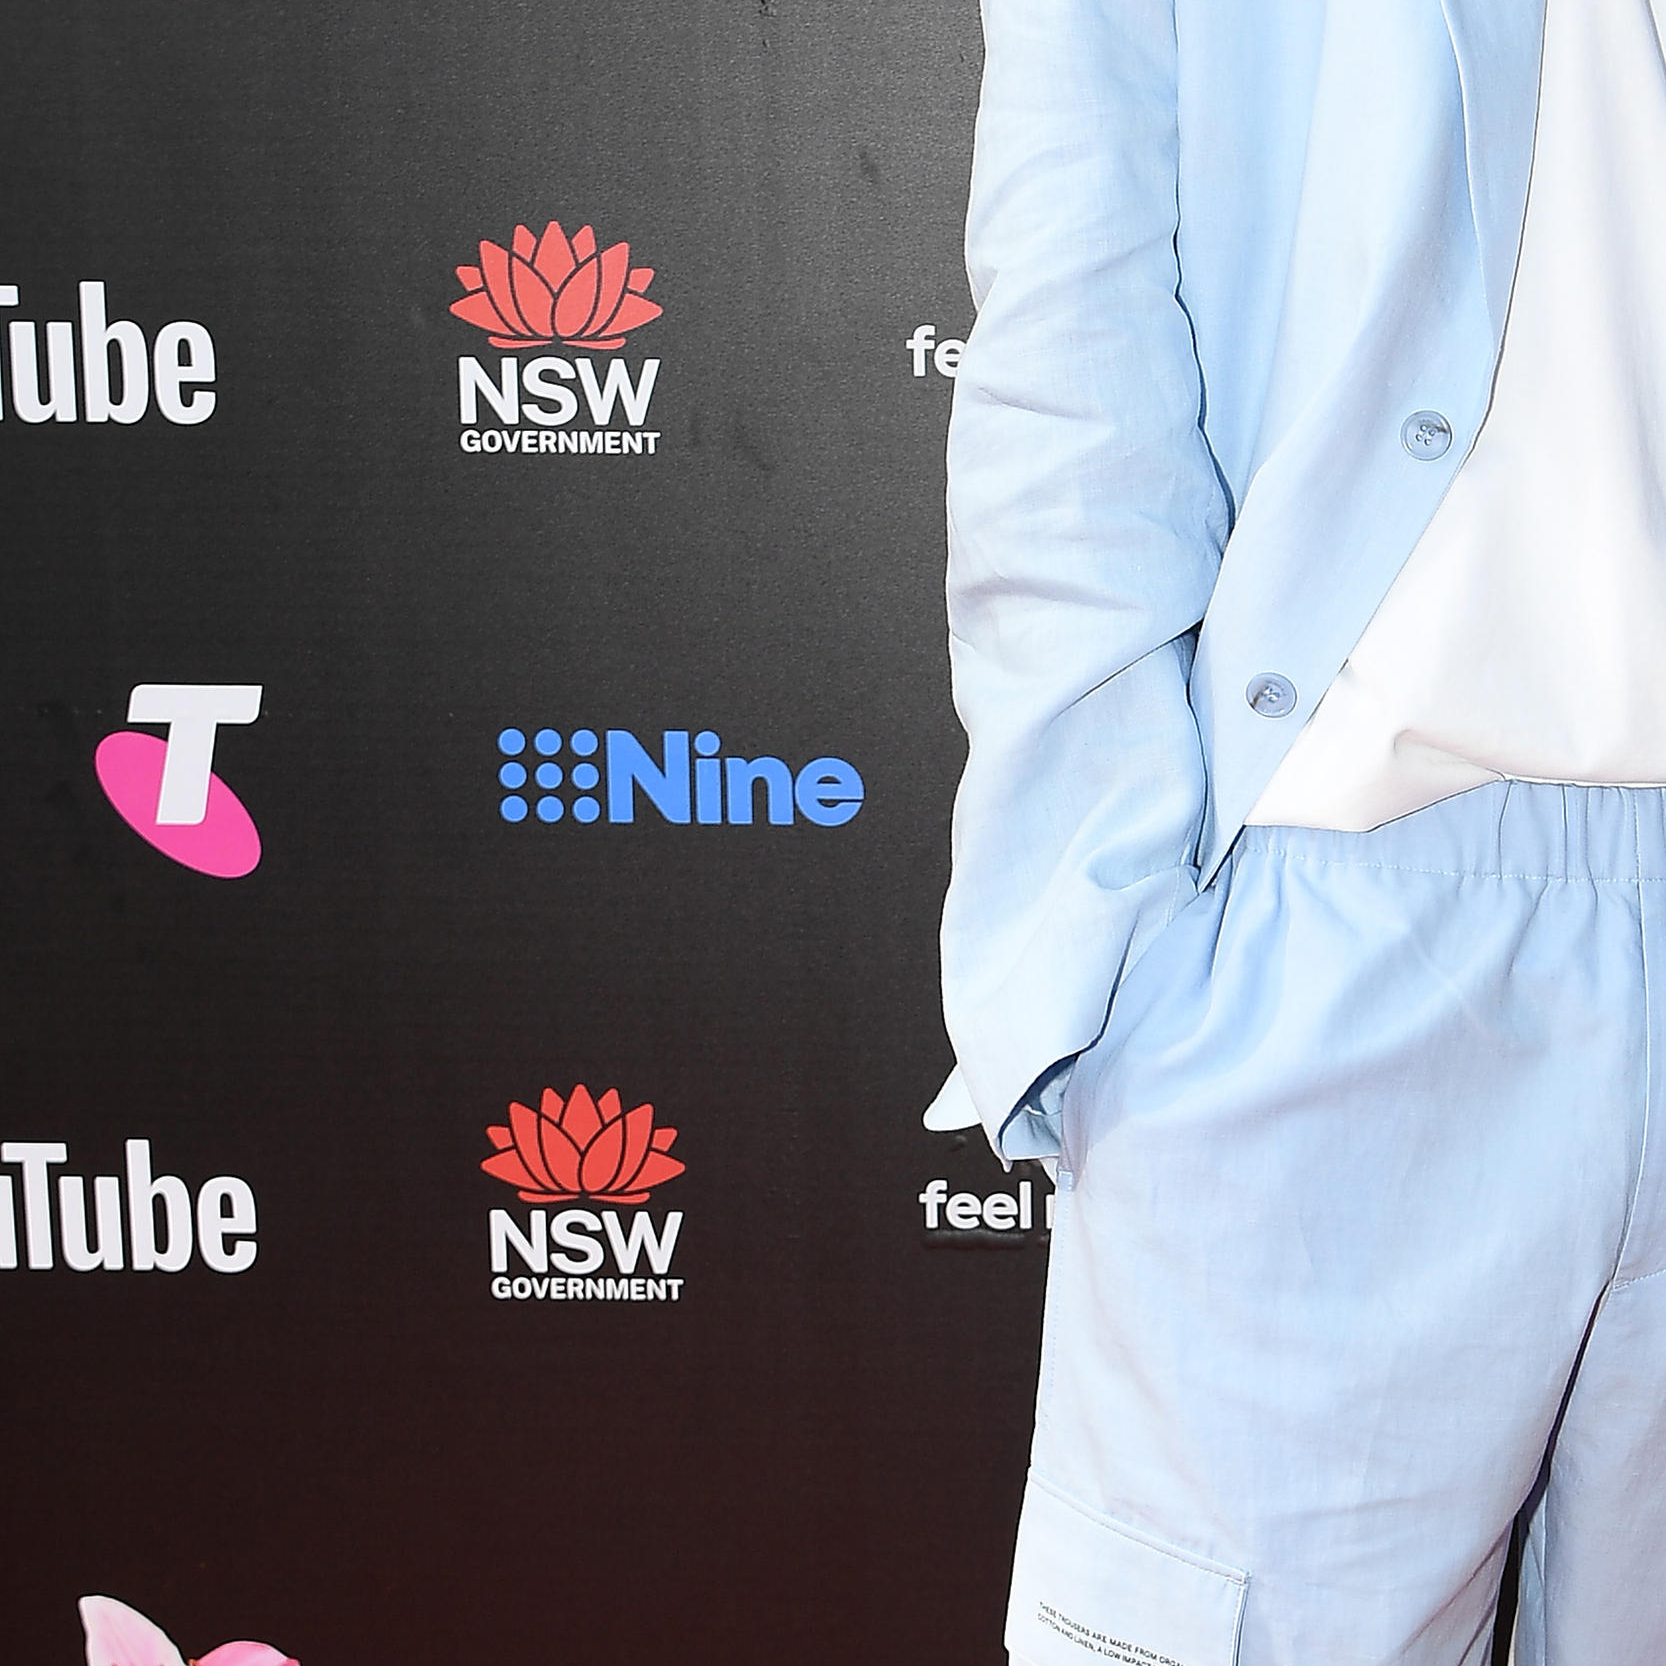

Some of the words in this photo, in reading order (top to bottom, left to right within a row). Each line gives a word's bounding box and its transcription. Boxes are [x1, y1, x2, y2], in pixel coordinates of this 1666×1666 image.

[0, 281, 216, 425] ube
[458, 356, 661, 427] NSW
[460, 429, 661, 455] GOVERNMENT
[605, 729, 865, 827] Nine
[0, 1139, 257, 1273] Tube
[918, 1179, 1033, 1230] feel
[489, 1208, 684, 1275] NSW
[491, 1277, 684, 1301] GOVERNMENT
[1104, 1648, 1121, 1660] LOW
[1109, 1638, 1132, 1652] MADE
[1134, 1646, 1157, 1661] FROM
